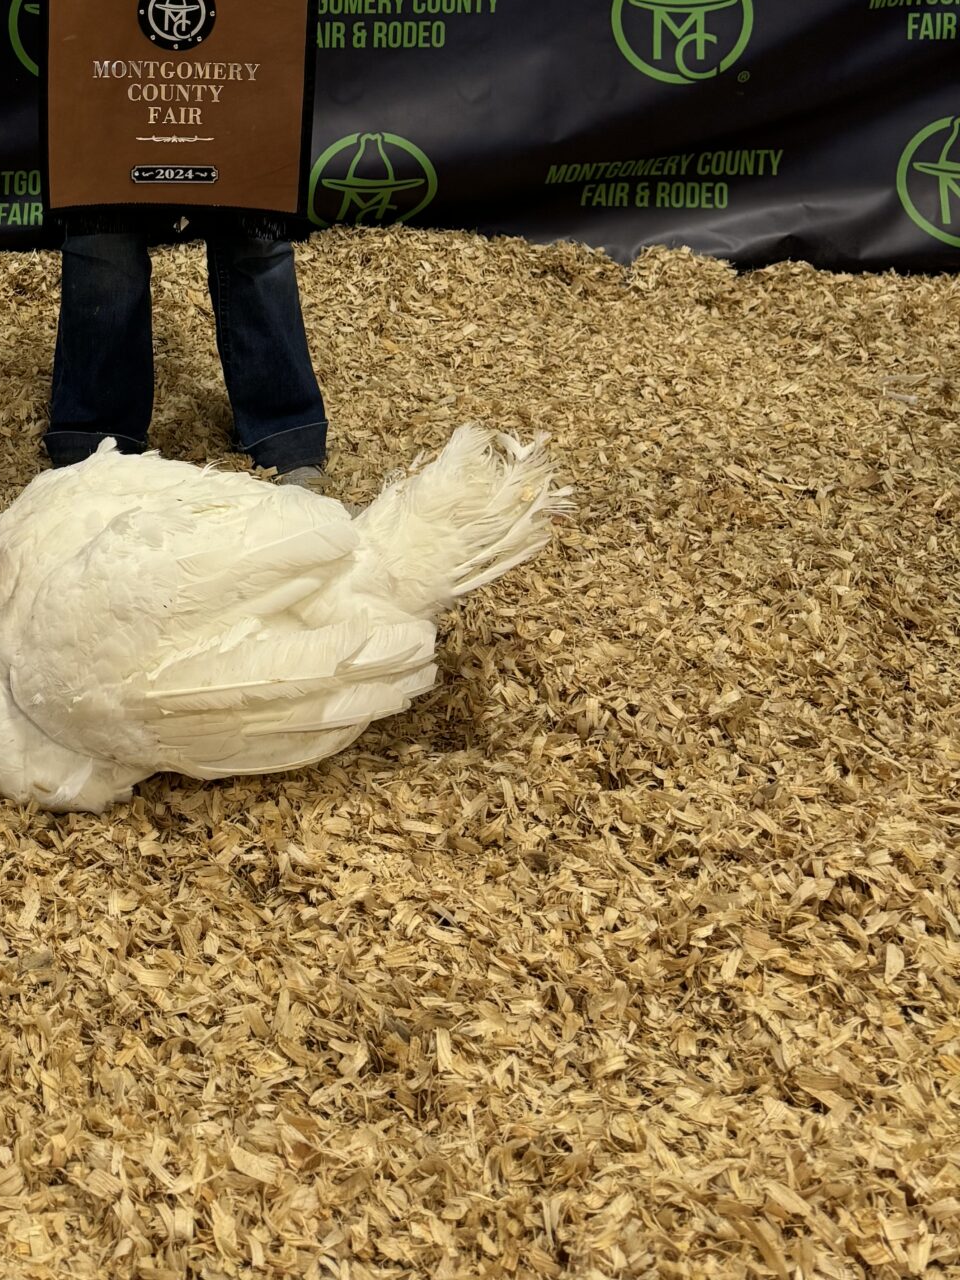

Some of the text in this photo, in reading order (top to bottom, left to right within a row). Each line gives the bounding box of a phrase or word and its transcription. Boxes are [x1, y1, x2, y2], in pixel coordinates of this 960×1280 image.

[352, 21, 367, 49] &
[373, 20, 446, 48] RODEO
[907, 12, 957, 40] FAIR
[92, 60, 261, 81] MONTGOMERY
[127, 83, 224, 103] COUNTY
[148, 106, 202, 125] FAIR
[155, 168, 195, 180] 2024
[545, 149, 784, 184] MONTGOMERY COUNTY
[581, 182, 728, 209] FAIR & RODEO
